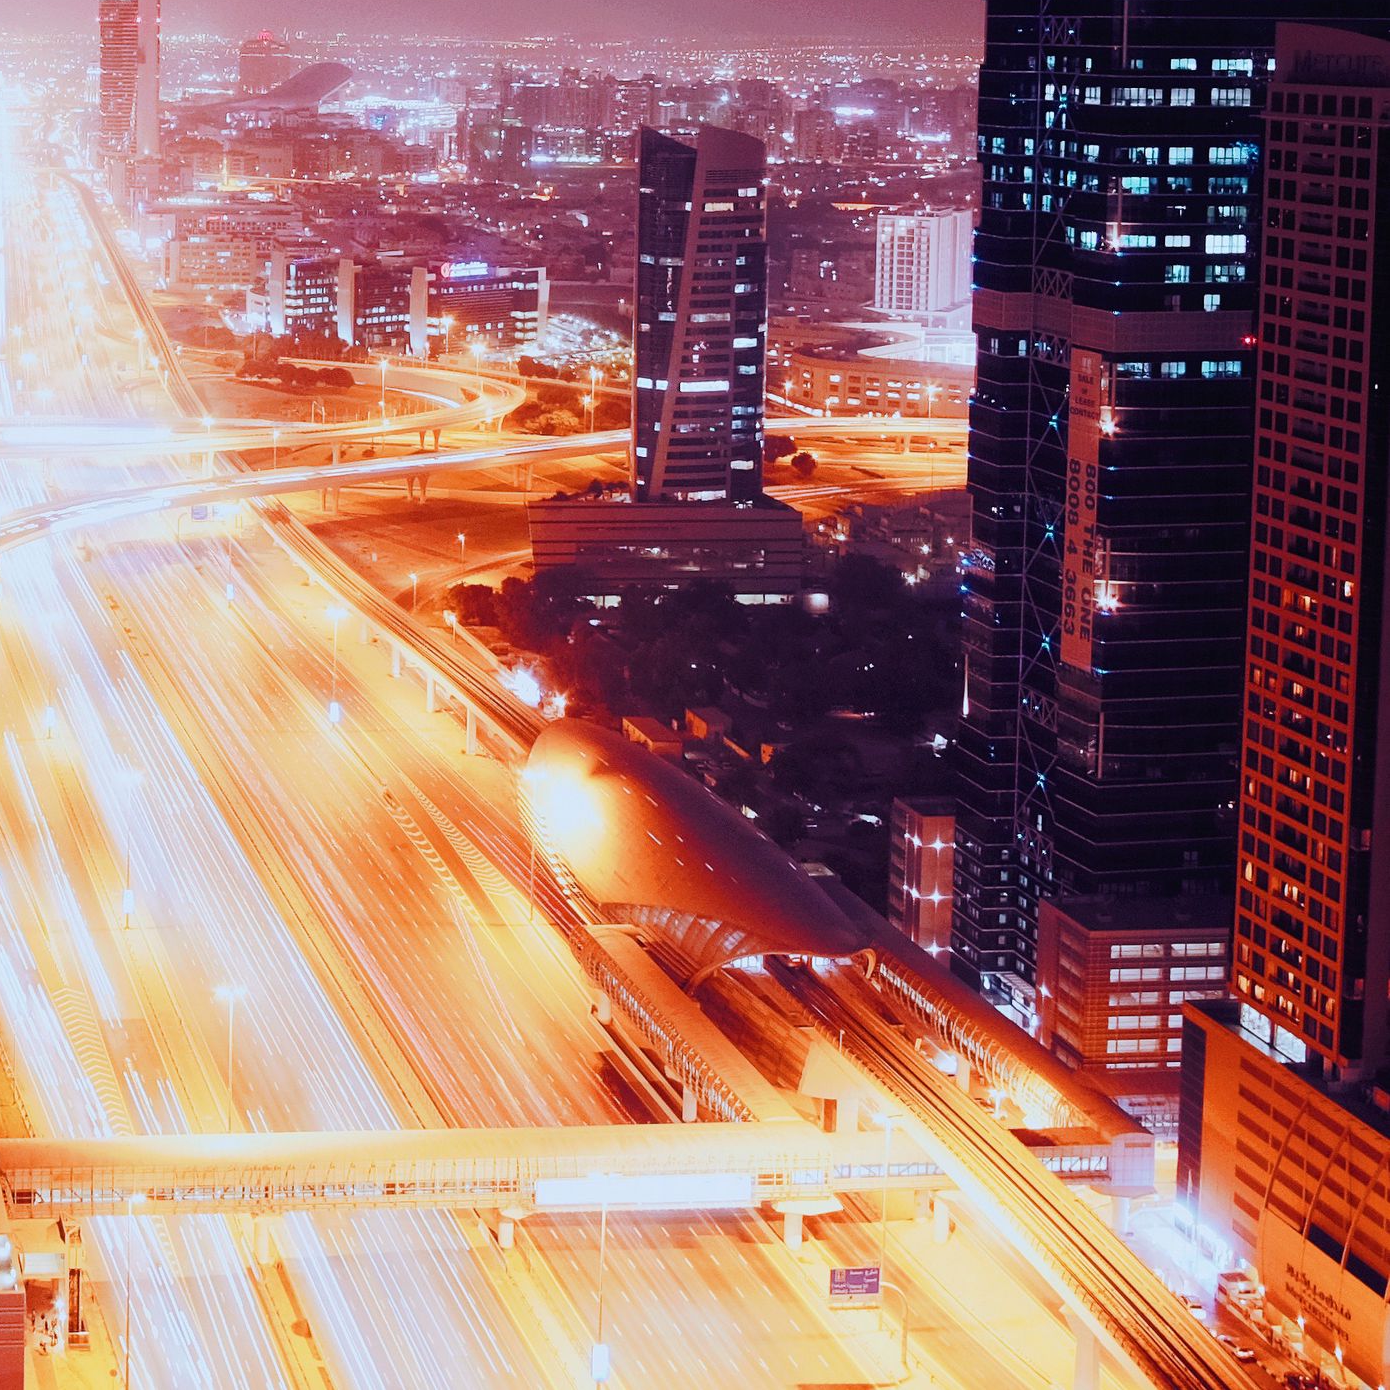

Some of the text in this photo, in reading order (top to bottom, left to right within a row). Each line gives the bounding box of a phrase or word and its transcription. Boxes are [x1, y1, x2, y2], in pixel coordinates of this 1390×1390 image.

[1064, 458, 1081, 636] 8008 4 3663
[1080, 464, 1096, 642] 800 THE ONE
